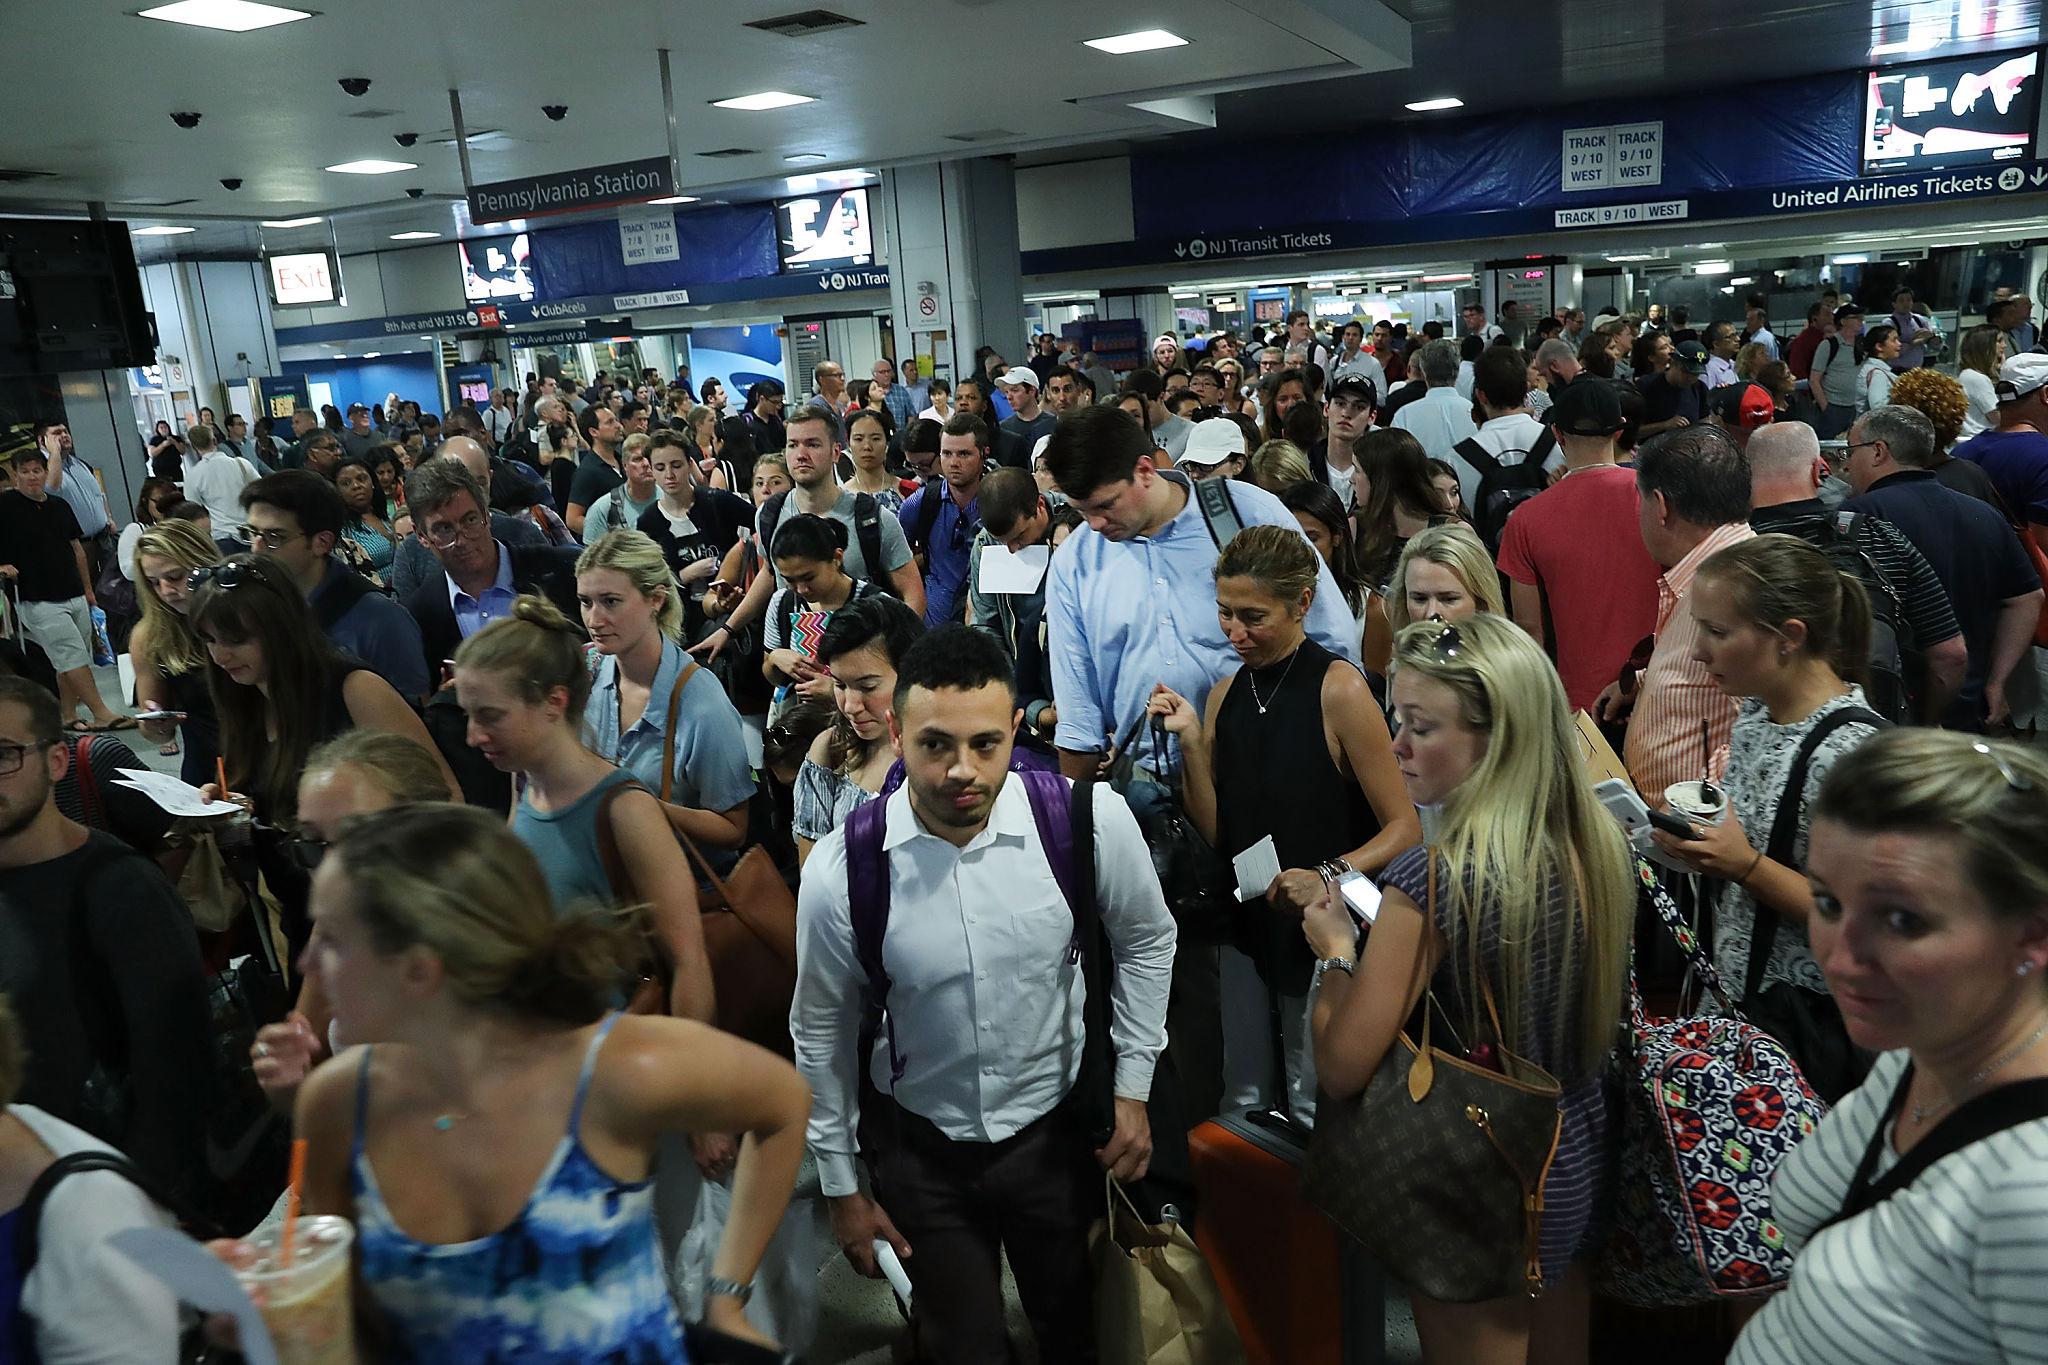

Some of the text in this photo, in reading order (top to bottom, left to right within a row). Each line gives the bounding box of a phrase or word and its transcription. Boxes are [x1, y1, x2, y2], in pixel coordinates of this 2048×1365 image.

[1569, 135, 1606, 149] TRACK
[1618, 131, 1656, 145] TRACK
[1571, 169, 1602, 182] WEST
[1620, 165, 1652, 178] WEST
[477, 170, 661, 212] Pennsylvania Station
[1772, 174, 1993, 209] United Airlines Tickets
[1558, 210, 1596, 224] TRACK
[1649, 204, 1681, 217] WEST
[623, 224, 644, 233] TRACK
[650, 221, 672, 230] TRACK
[654, 245, 673, 255] WEST
[1209, 232, 1332, 254] NJ Transit Tickets
[627, 248, 646, 258] WEST
[847, 272, 890, 287] NJ Tran
[616, 297, 638, 307] TRACK
[665, 293, 684, 302] WEST
[540, 301, 587, 317] ClubAcela
[384, 311, 497, 332] 8th Ave and W 31 St Exit
[527, 335, 545, 344] Ave
[546, 333, 564, 343] and
[565, 332, 576, 340] W
[577, 331, 587, 340] 31
